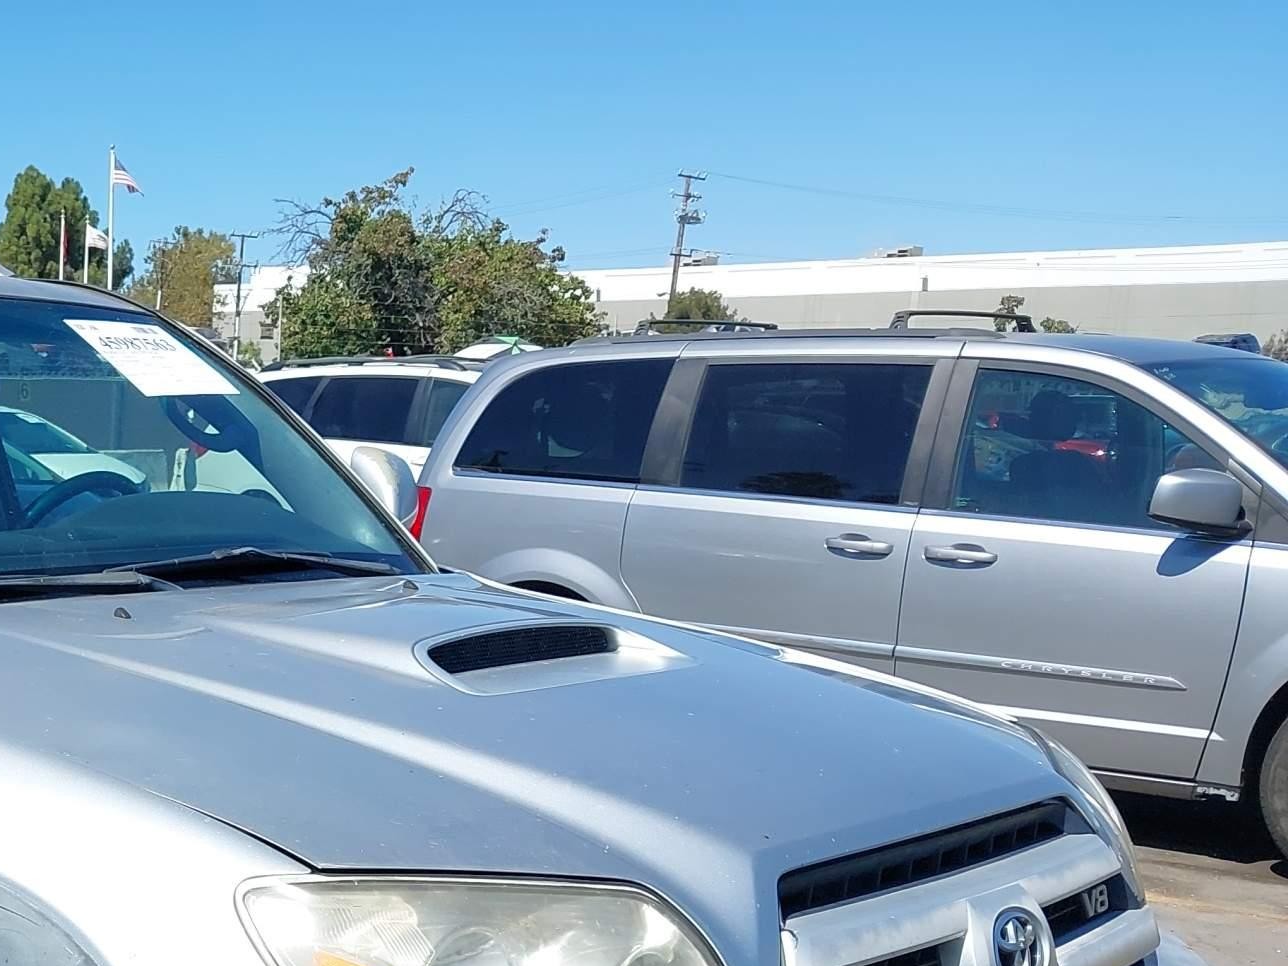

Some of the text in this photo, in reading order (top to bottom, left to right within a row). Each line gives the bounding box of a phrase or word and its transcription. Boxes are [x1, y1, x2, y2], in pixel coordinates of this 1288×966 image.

[98, 335, 177, 352] 45987563
[1000, 660, 1157, 685] CHRYSLER
[1081, 883, 1110, 919] V8
